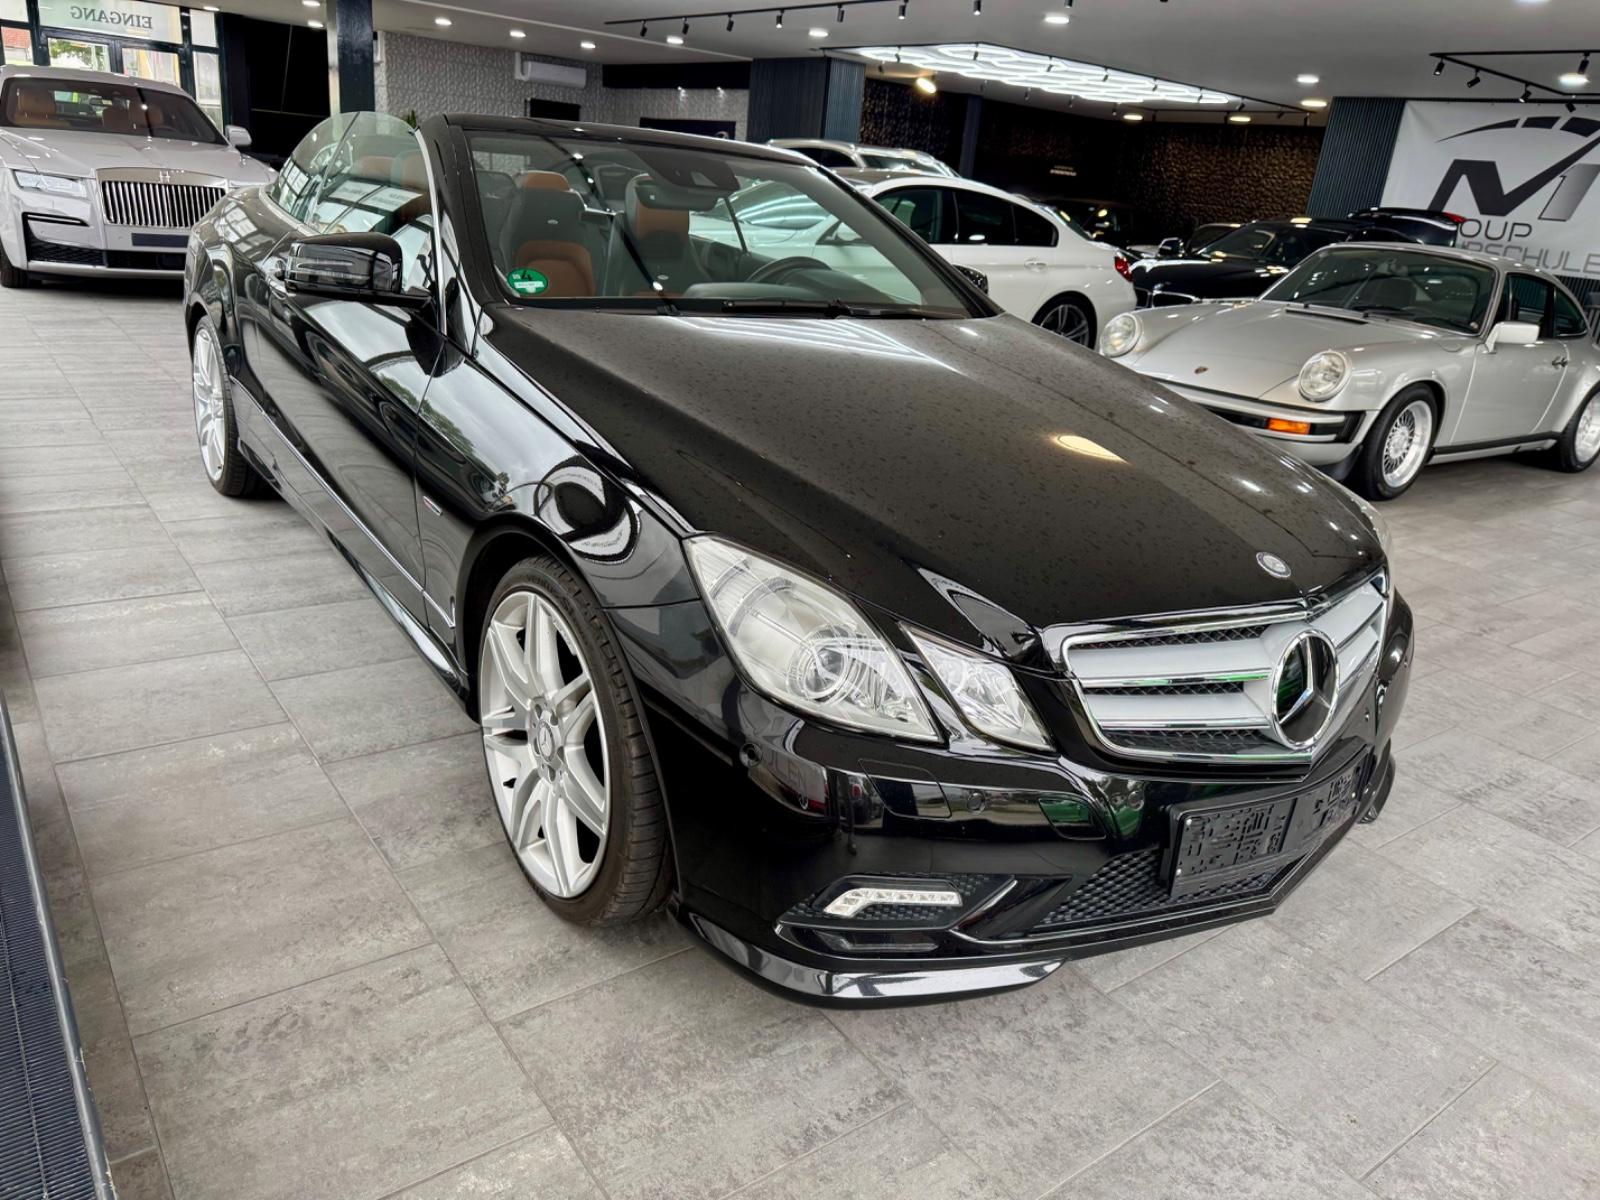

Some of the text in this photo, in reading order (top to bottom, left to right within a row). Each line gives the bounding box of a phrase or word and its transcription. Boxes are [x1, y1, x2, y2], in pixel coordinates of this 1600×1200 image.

[1459, 218, 1533, 242] OUP
[1462, 241, 1600, 274] RSCHULE
[521, 270, 533, 282] 4
